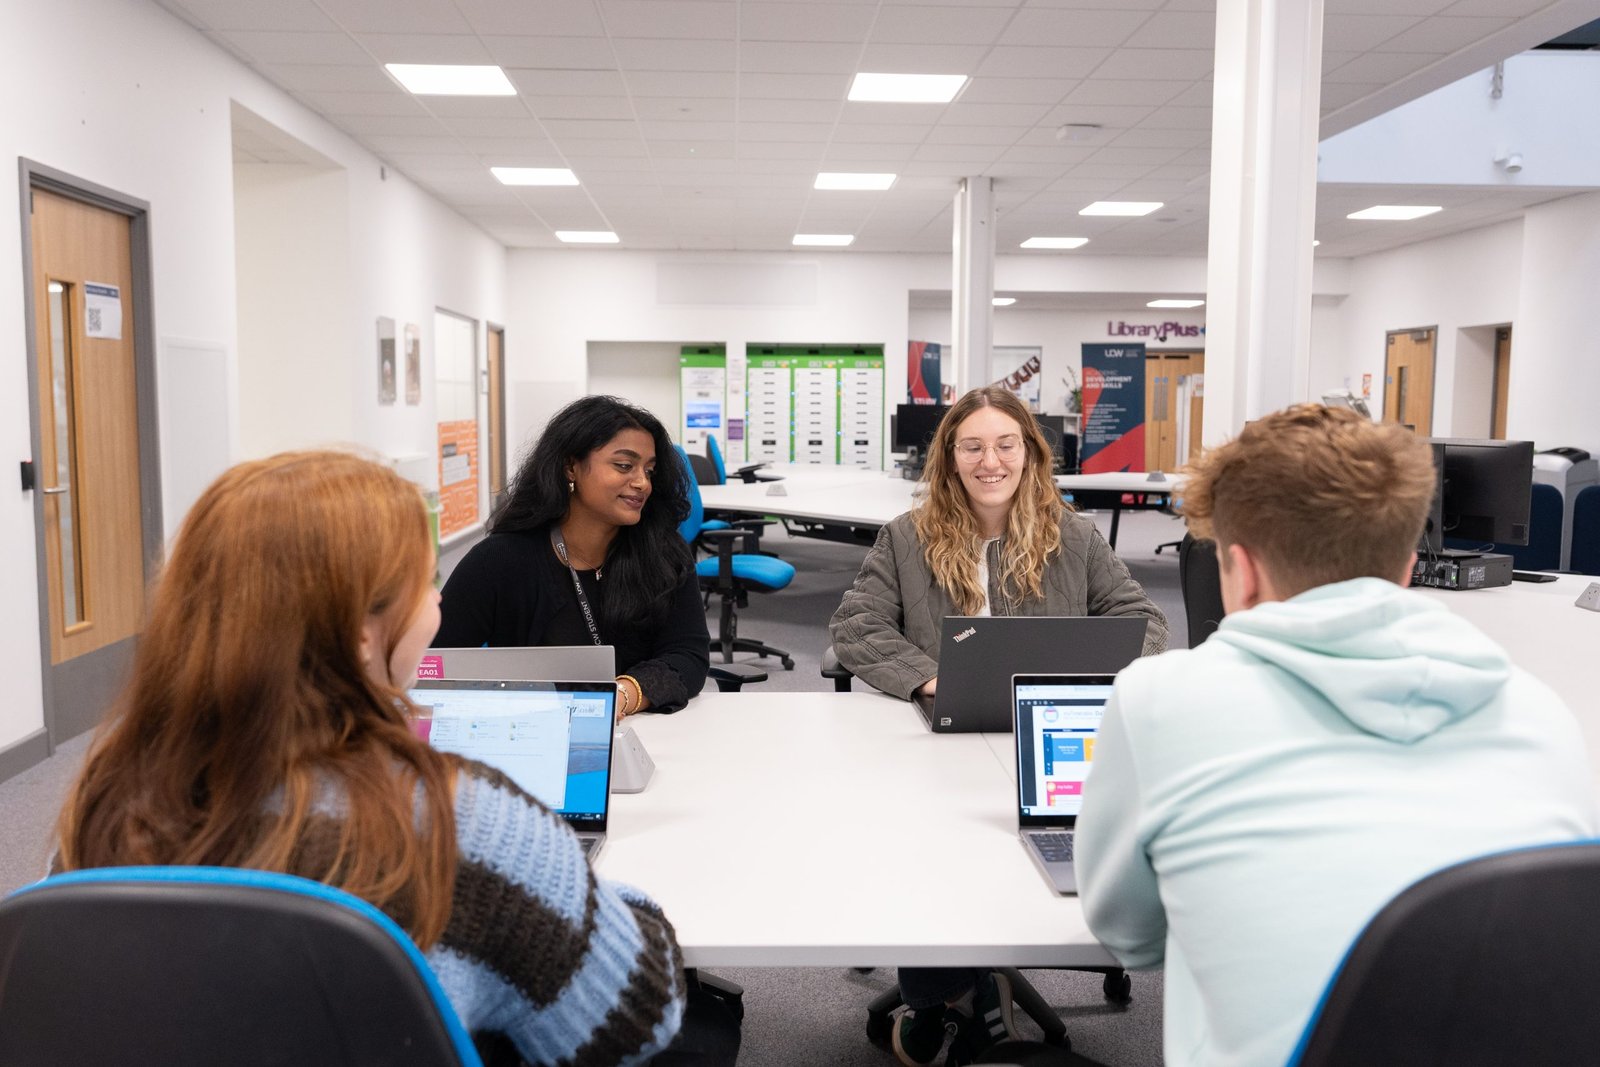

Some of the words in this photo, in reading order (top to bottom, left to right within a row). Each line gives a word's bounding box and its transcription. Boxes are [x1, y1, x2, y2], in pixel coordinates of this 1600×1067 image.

[1107, 321, 1199, 340] LibraryPlus
[1104, 349, 1124, 358] UCW
[581, 600, 597, 632] STUDENT
[592, 633, 602, 647] CW
